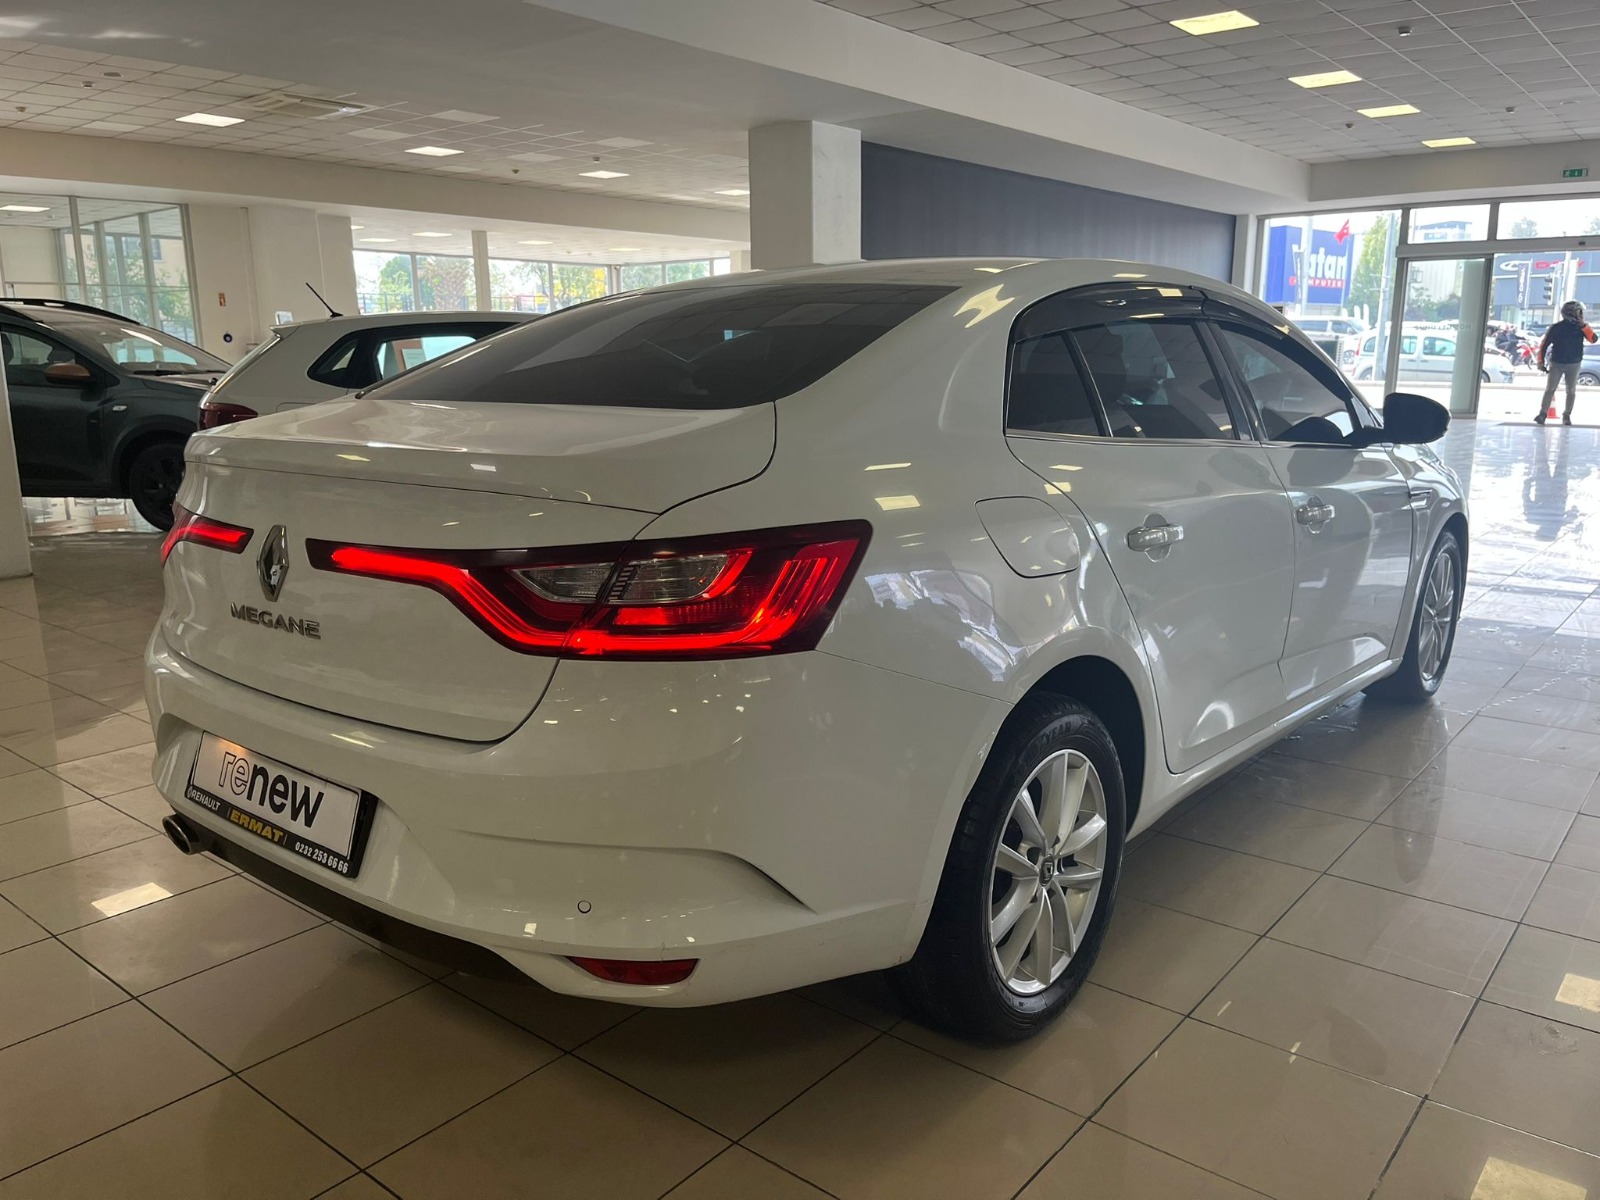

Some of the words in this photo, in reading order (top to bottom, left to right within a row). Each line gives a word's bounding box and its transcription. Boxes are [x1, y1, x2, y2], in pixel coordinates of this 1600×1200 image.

[1290, 277, 1343, 288] MPUTER
[231, 602, 321, 640] MEGANE
[218, 752, 325, 829] renew
[192, 790, 221, 811] RENAULT
[230, 809, 283, 842] ERMAT
[295, 842, 312, 857] 0232
[312, 848, 328, 864] 253
